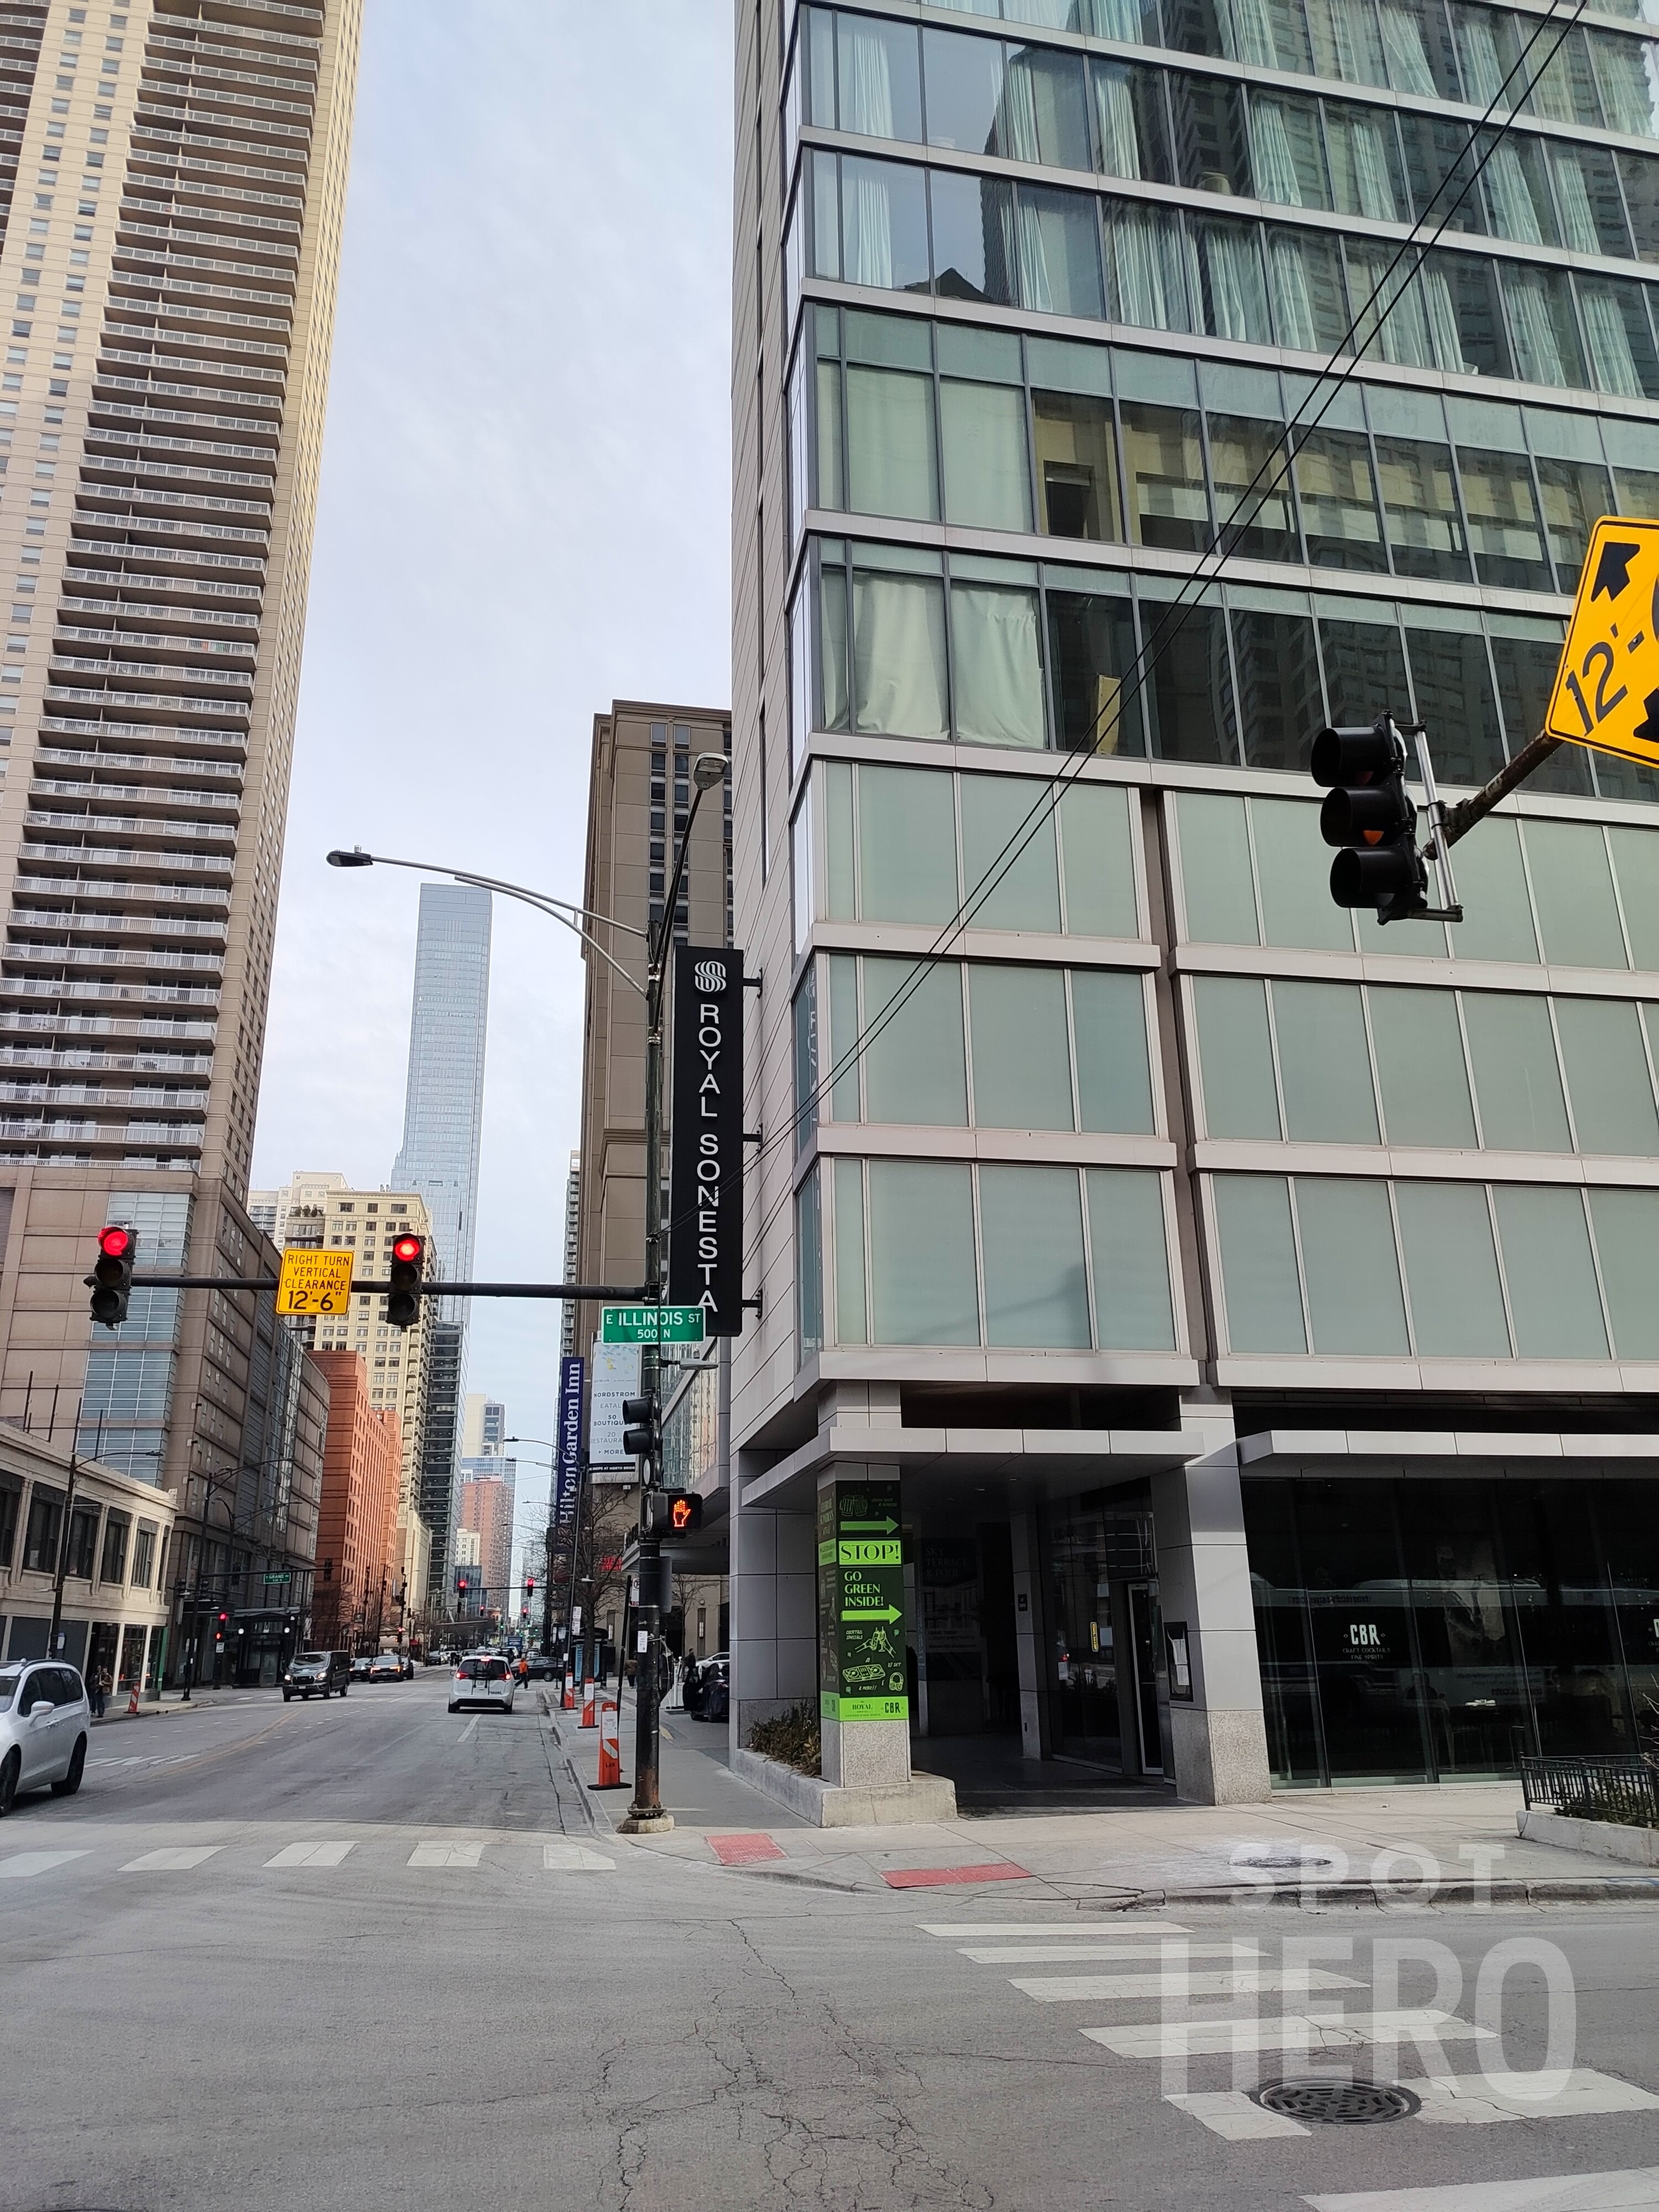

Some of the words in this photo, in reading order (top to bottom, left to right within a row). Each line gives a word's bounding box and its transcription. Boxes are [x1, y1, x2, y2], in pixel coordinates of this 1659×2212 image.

[1565, 576, 1659, 737] 12'-
[698, 1004, 722, 1117] ROYAL
[696, 1134, 720, 1312] SONESTA
[288, 1254, 319, 1265] RIGHT
[324, 1256, 350, 1266] TURN
[294, 1266, 342, 1278] VERTICAL
[285, 1278, 347, 1291] CLEARANCE
[288, 1290, 342, 1311] 12'-6"
[606, 1314, 613, 1324] E
[618, 1311, 683, 1326] ILLINOIS
[688, 1313, 701, 1323] ST
[637, 1329, 658, 1339] 500
[663, 1329, 671, 1338] N
[565, 1363, 580, 1394] Inn
[562, 1397, 579, 1464] Garden
[559, 1467, 577, 1524] Hilton
[841, 1544, 899, 1560] STOP!
[844, 1571, 862, 1582] GO
[844, 1583, 880, 1594] GREEN
[845, 1596, 884, 1606] INSIDE!
[1350, 1624, 1381, 1645] CBR
[885, 1702, 901, 1713] CBR
